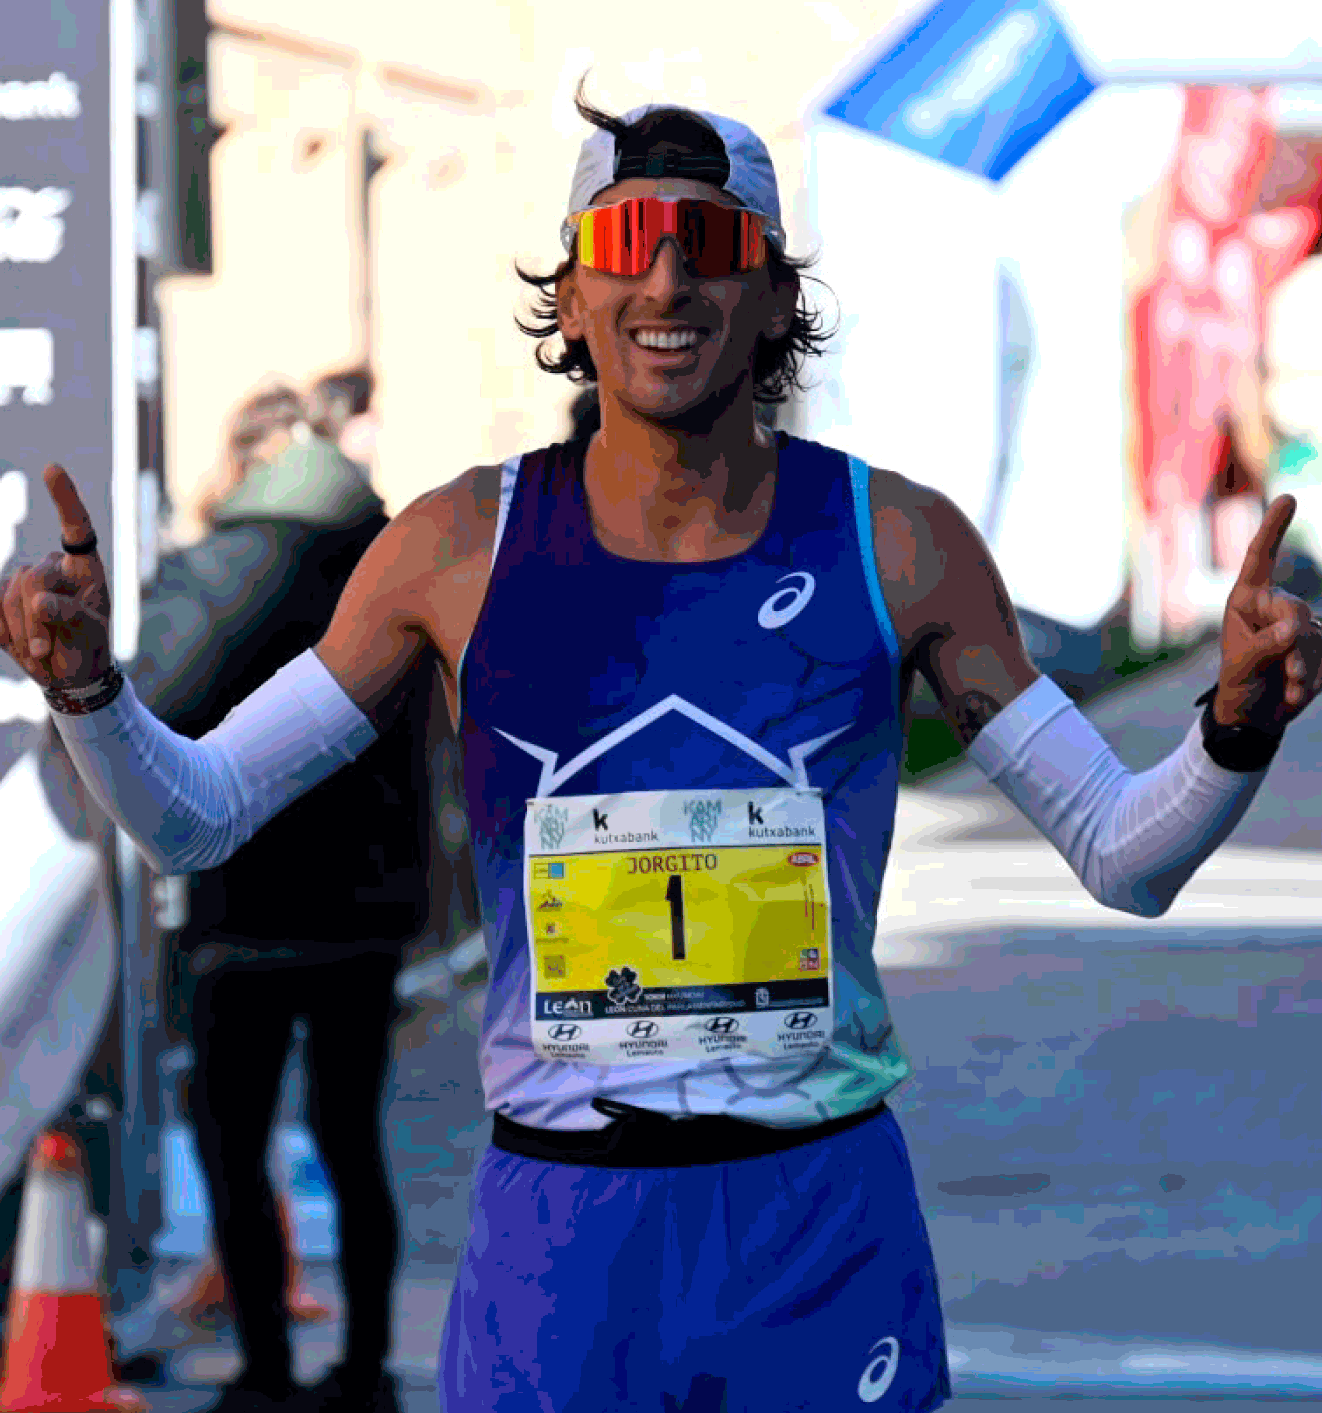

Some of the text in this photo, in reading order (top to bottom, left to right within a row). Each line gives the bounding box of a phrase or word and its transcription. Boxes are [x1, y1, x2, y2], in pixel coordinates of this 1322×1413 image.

[593, 808, 609, 831] k
[748, 801, 764, 825] k
[594, 831, 659, 845] kutxabank
[748, 826, 815, 838] kutxabank
[627, 853, 718, 875] JORGITO
[664, 874, 686, 960] 1
[698, 1034, 748, 1046] HYUNDAI
[776, 1030, 825, 1042] HYUNDAI
[619, 1039, 669, 1050] HYUNDAI
